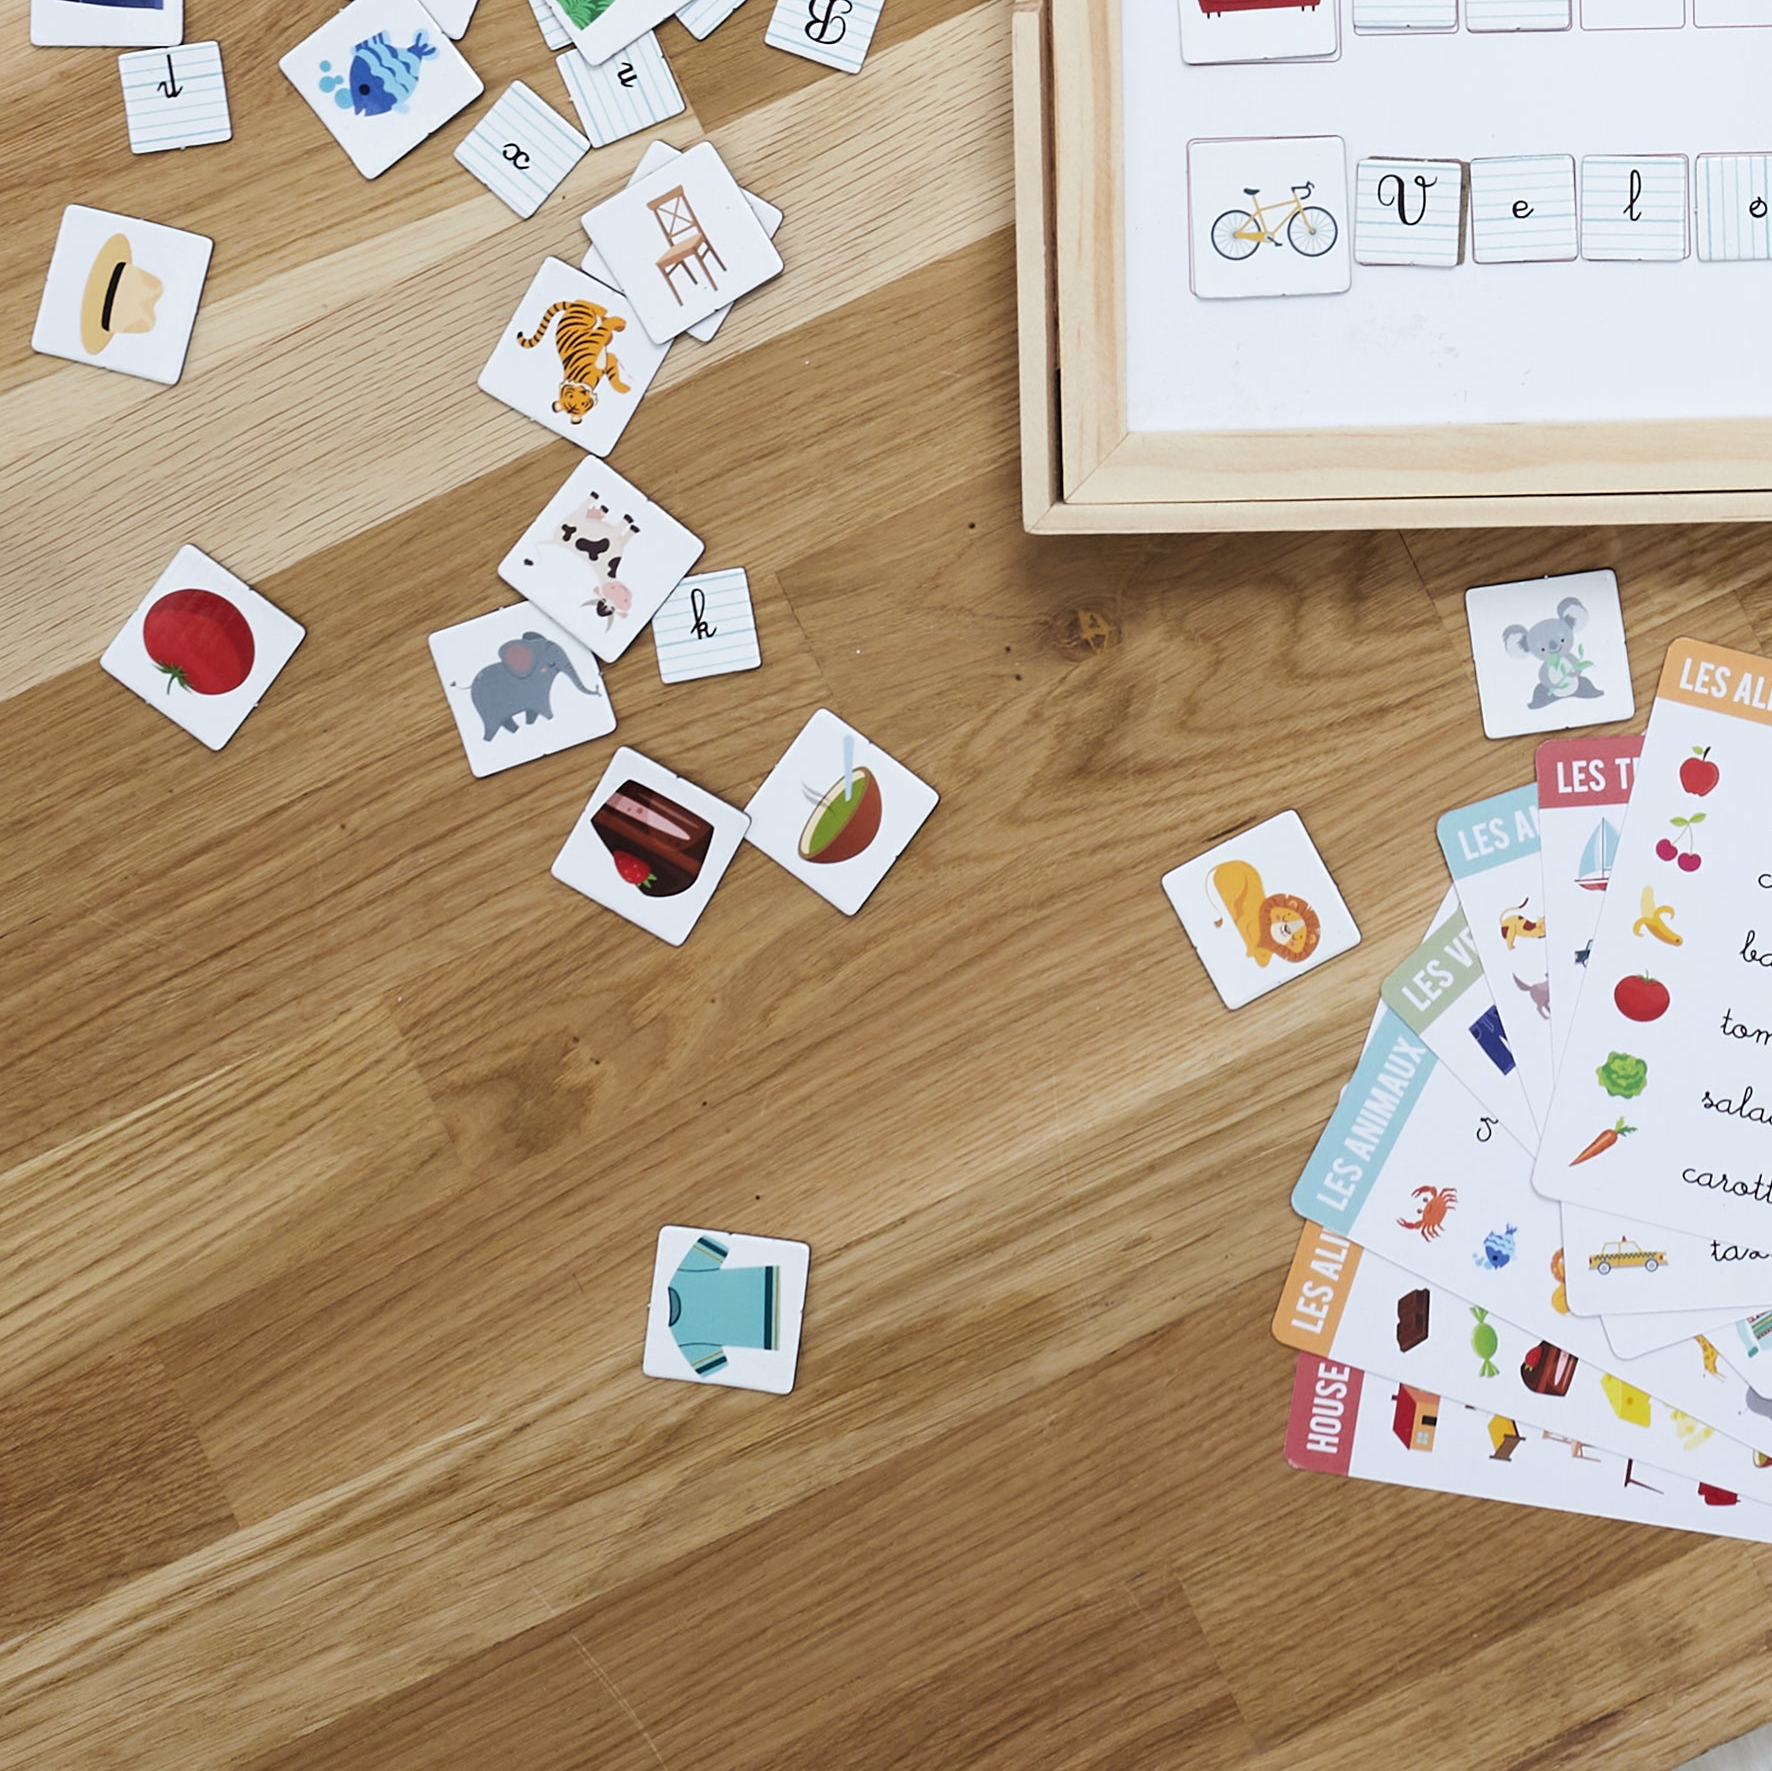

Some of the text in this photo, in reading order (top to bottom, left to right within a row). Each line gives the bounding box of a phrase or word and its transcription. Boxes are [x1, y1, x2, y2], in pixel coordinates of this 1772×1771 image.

[502, 142, 530, 171] x
[690, 588, 718, 641] k
[1679, 657, 1731, 699] LES
[1556, 758, 1606, 794] LES
[1457, 816, 1511, 861] LES
[1401, 959, 1454, 1012] LES
[1316, 1035, 1427, 1212] LES ANIMAUX
[1291, 1280, 1335, 1335] LES
[1306, 1362, 1350, 1454] HOUSE
